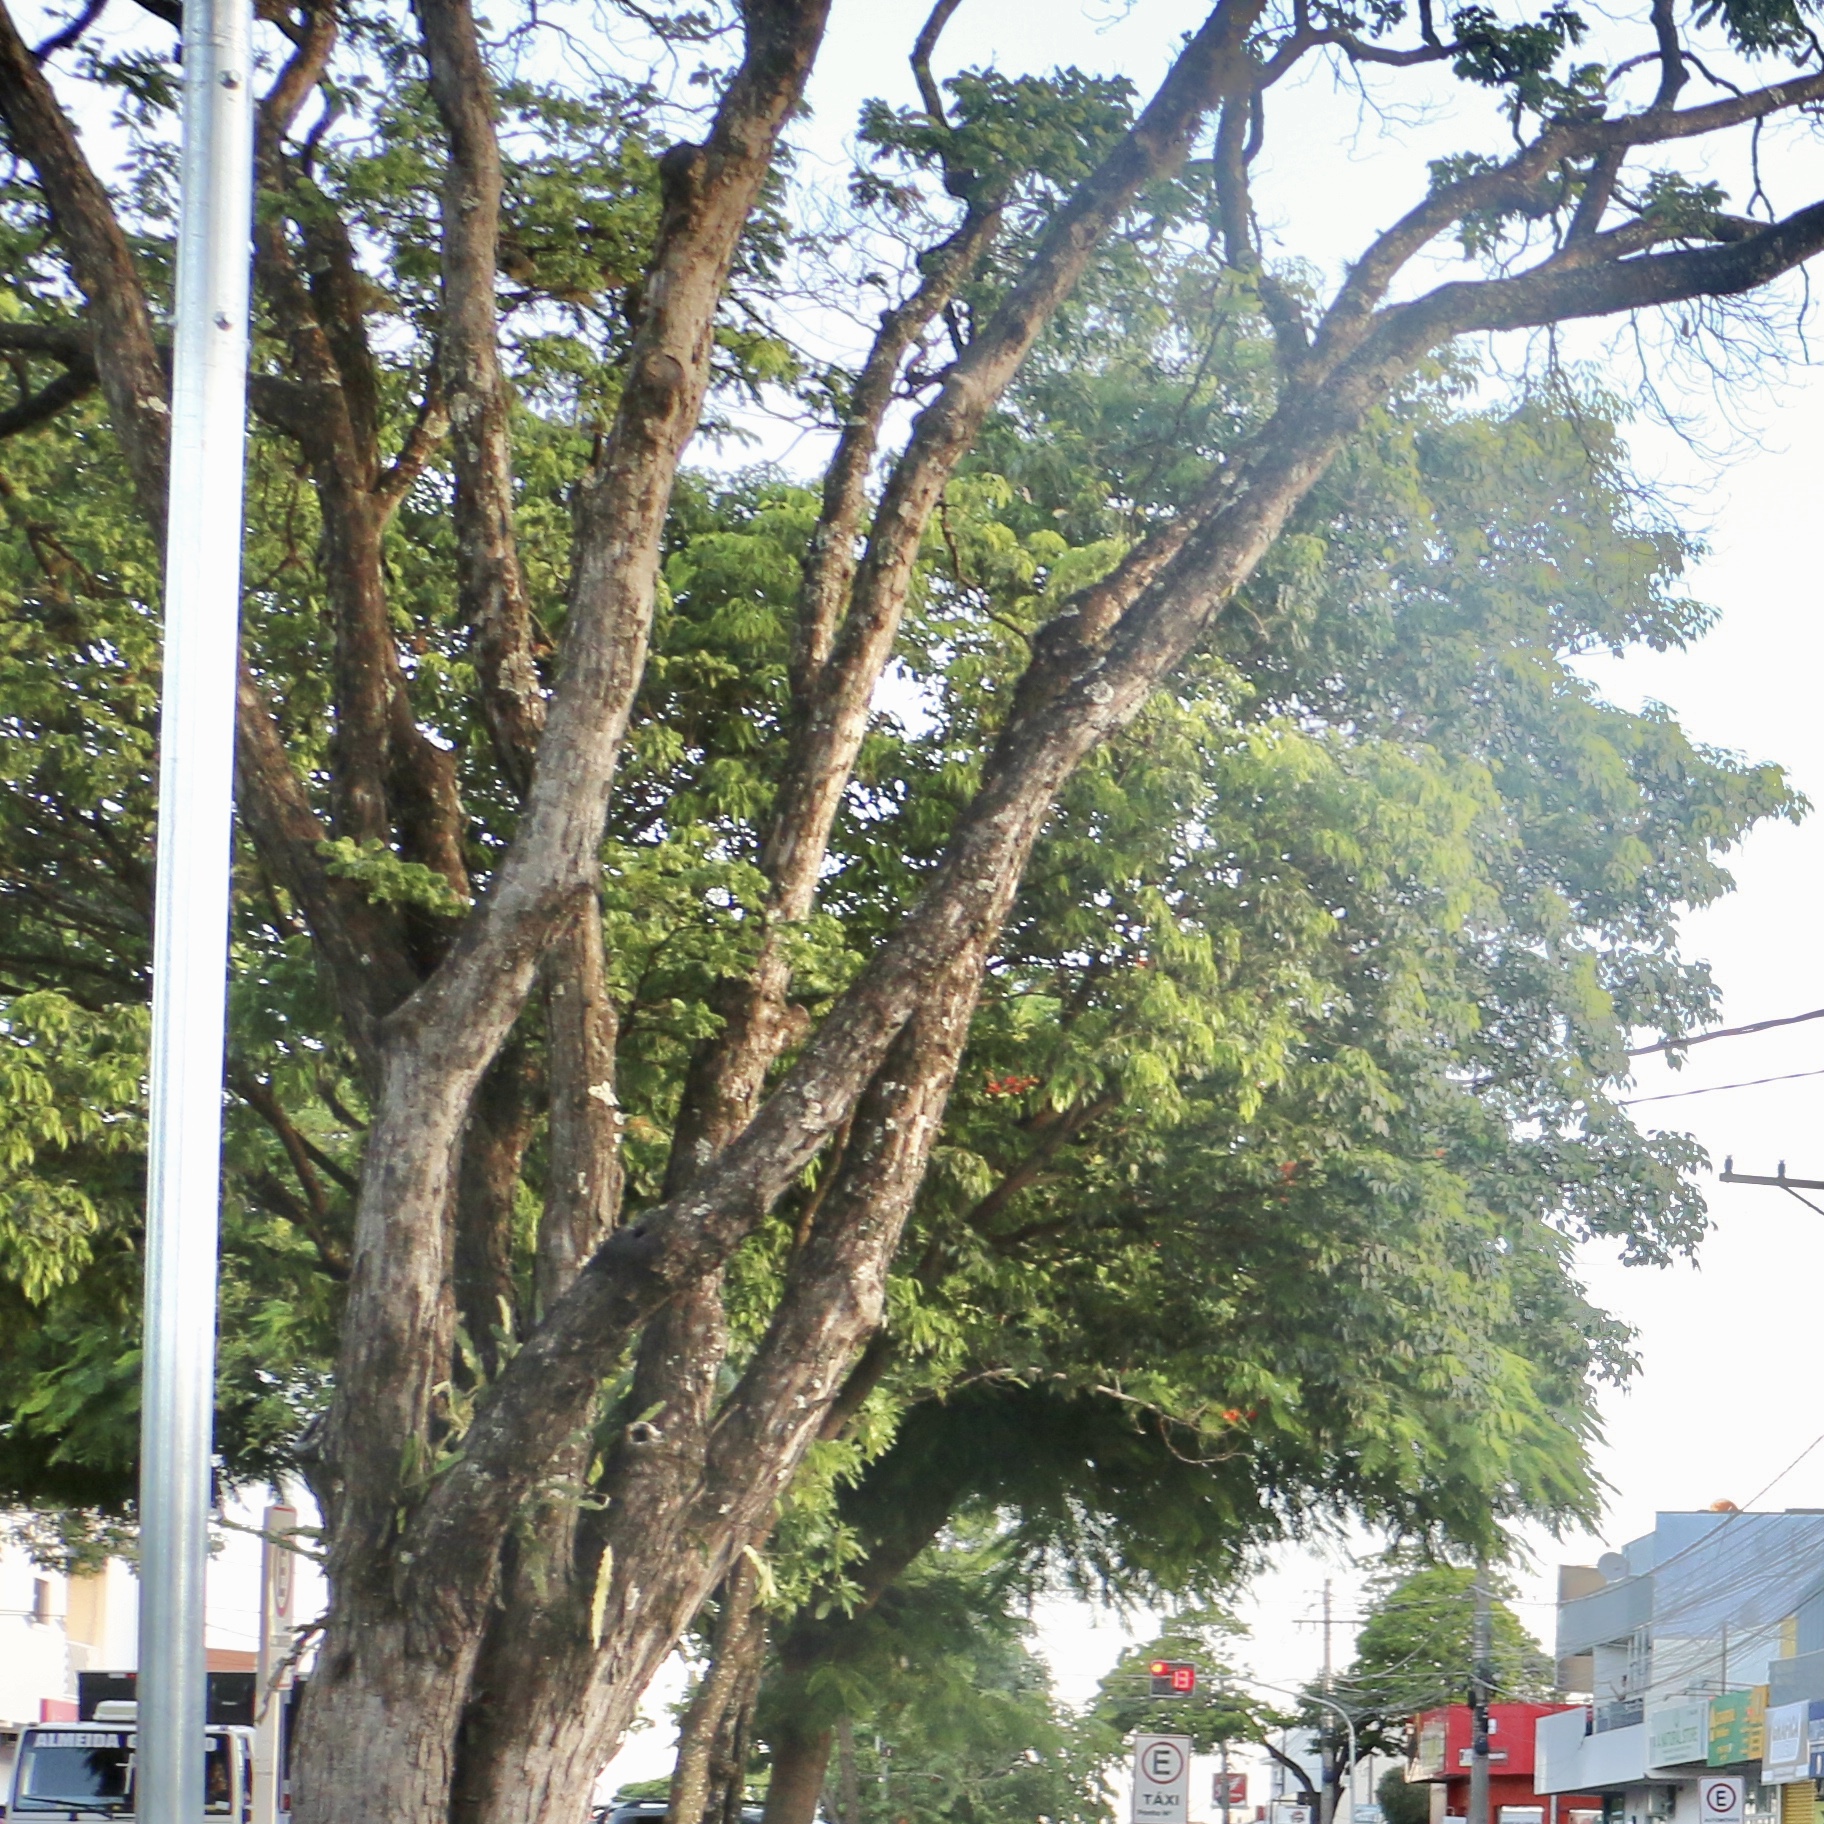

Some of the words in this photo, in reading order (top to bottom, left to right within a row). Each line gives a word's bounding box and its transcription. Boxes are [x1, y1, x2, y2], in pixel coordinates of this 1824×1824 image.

[33, 1732, 120, 1749] ALMEIDA
[1152, 1749, 1171, 1776] E
[1142, 1790, 1179, 1806] TÁXI
[1716, 1790, 1727, 1807] E
